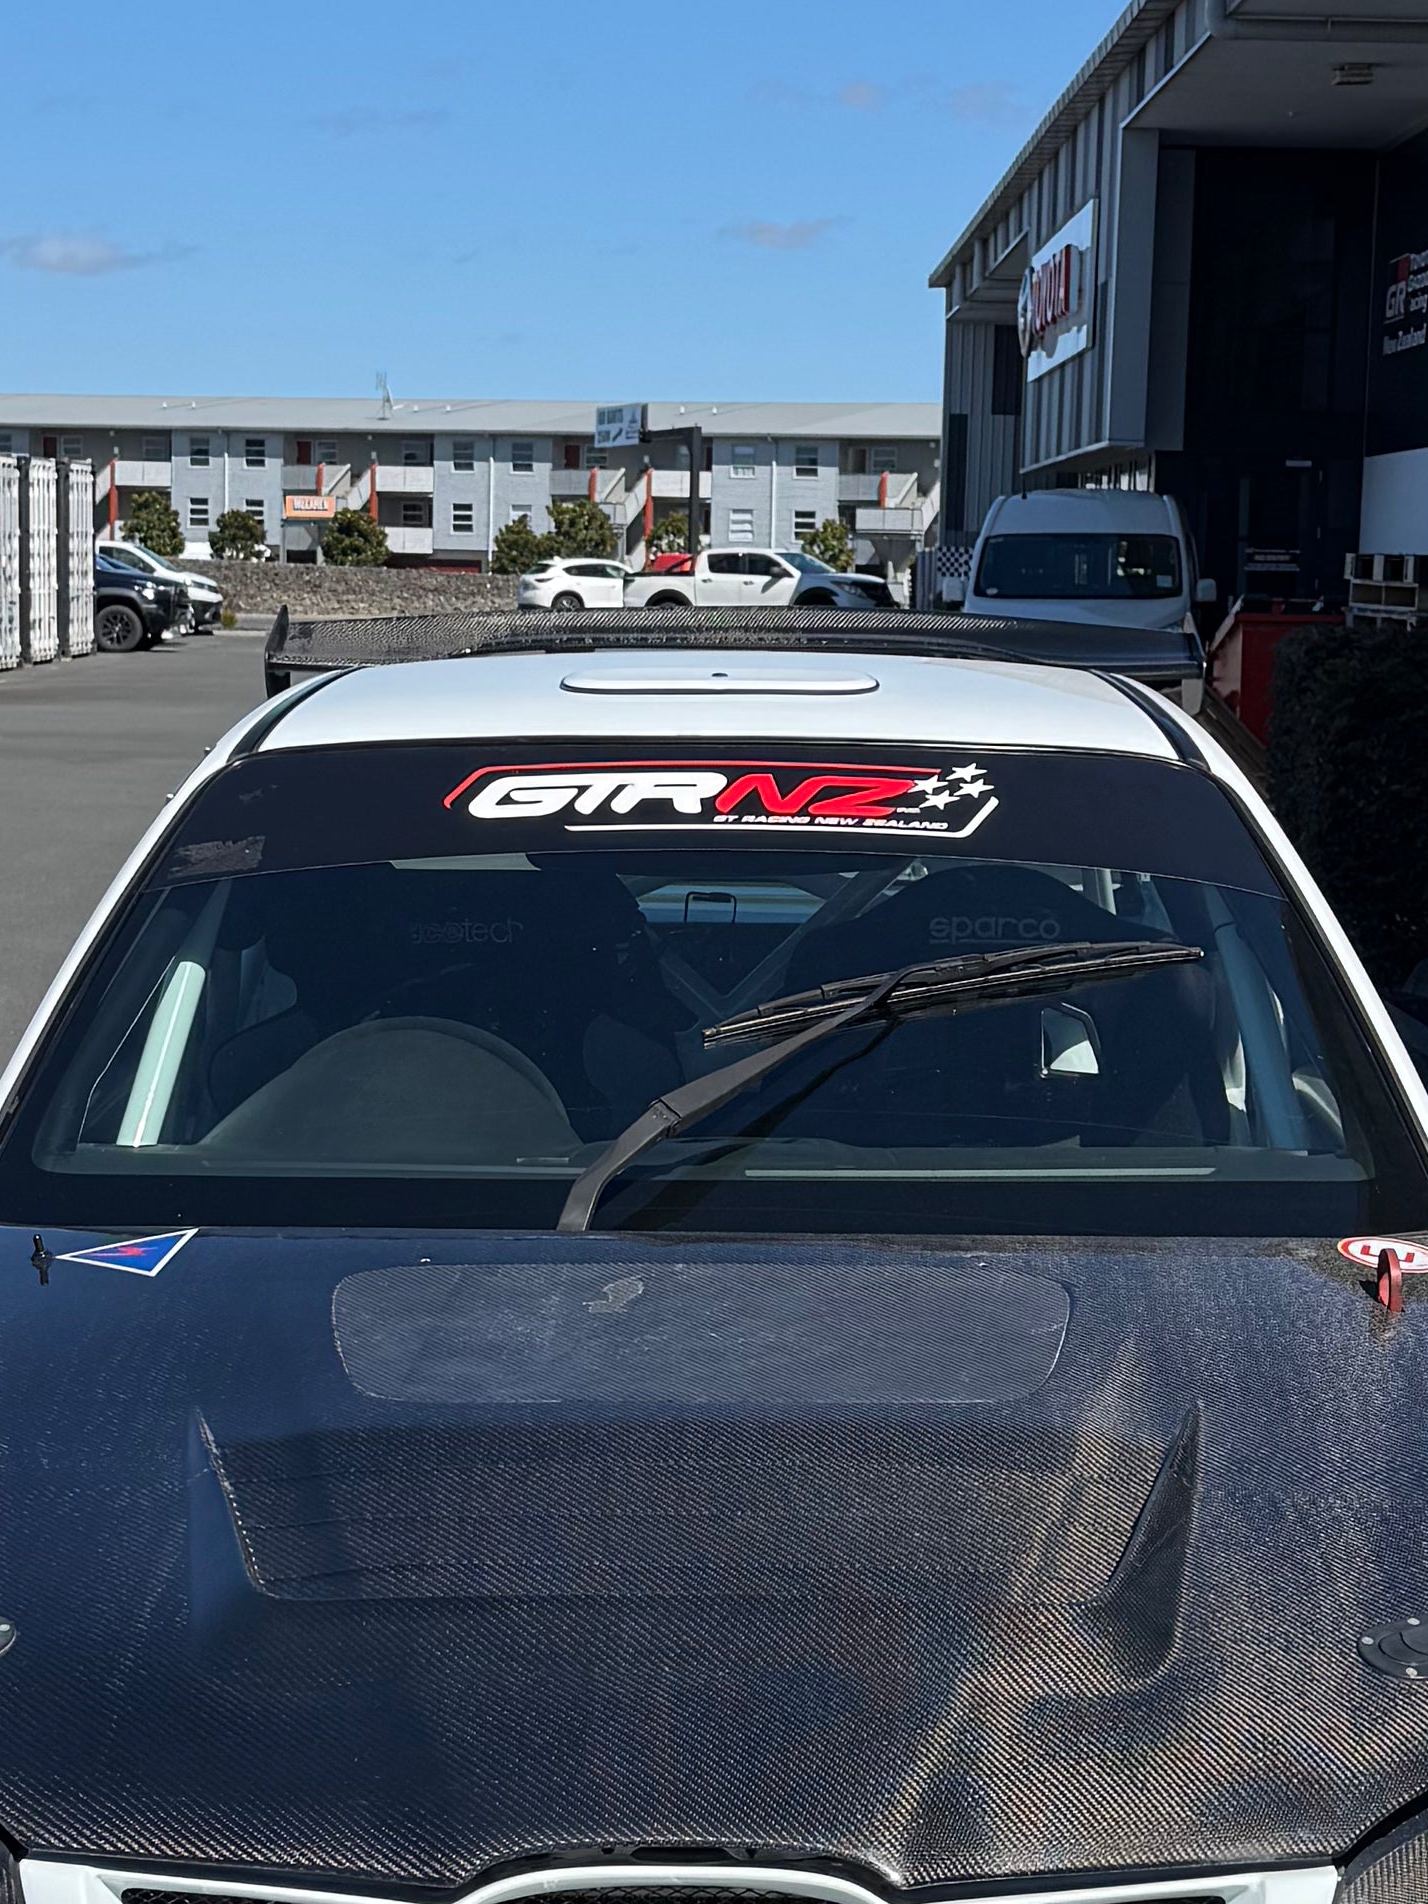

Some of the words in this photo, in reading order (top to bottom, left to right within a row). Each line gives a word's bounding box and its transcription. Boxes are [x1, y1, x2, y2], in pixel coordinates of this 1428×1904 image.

[1385, 280, 1407, 318] GR
[713, 814, 739, 823] GT
[741, 814, 811, 824] RACING
[814, 816, 859, 825] NEW
[862, 818, 949, 830] ZEALAND
[929, 915, 1061, 944] sparco
